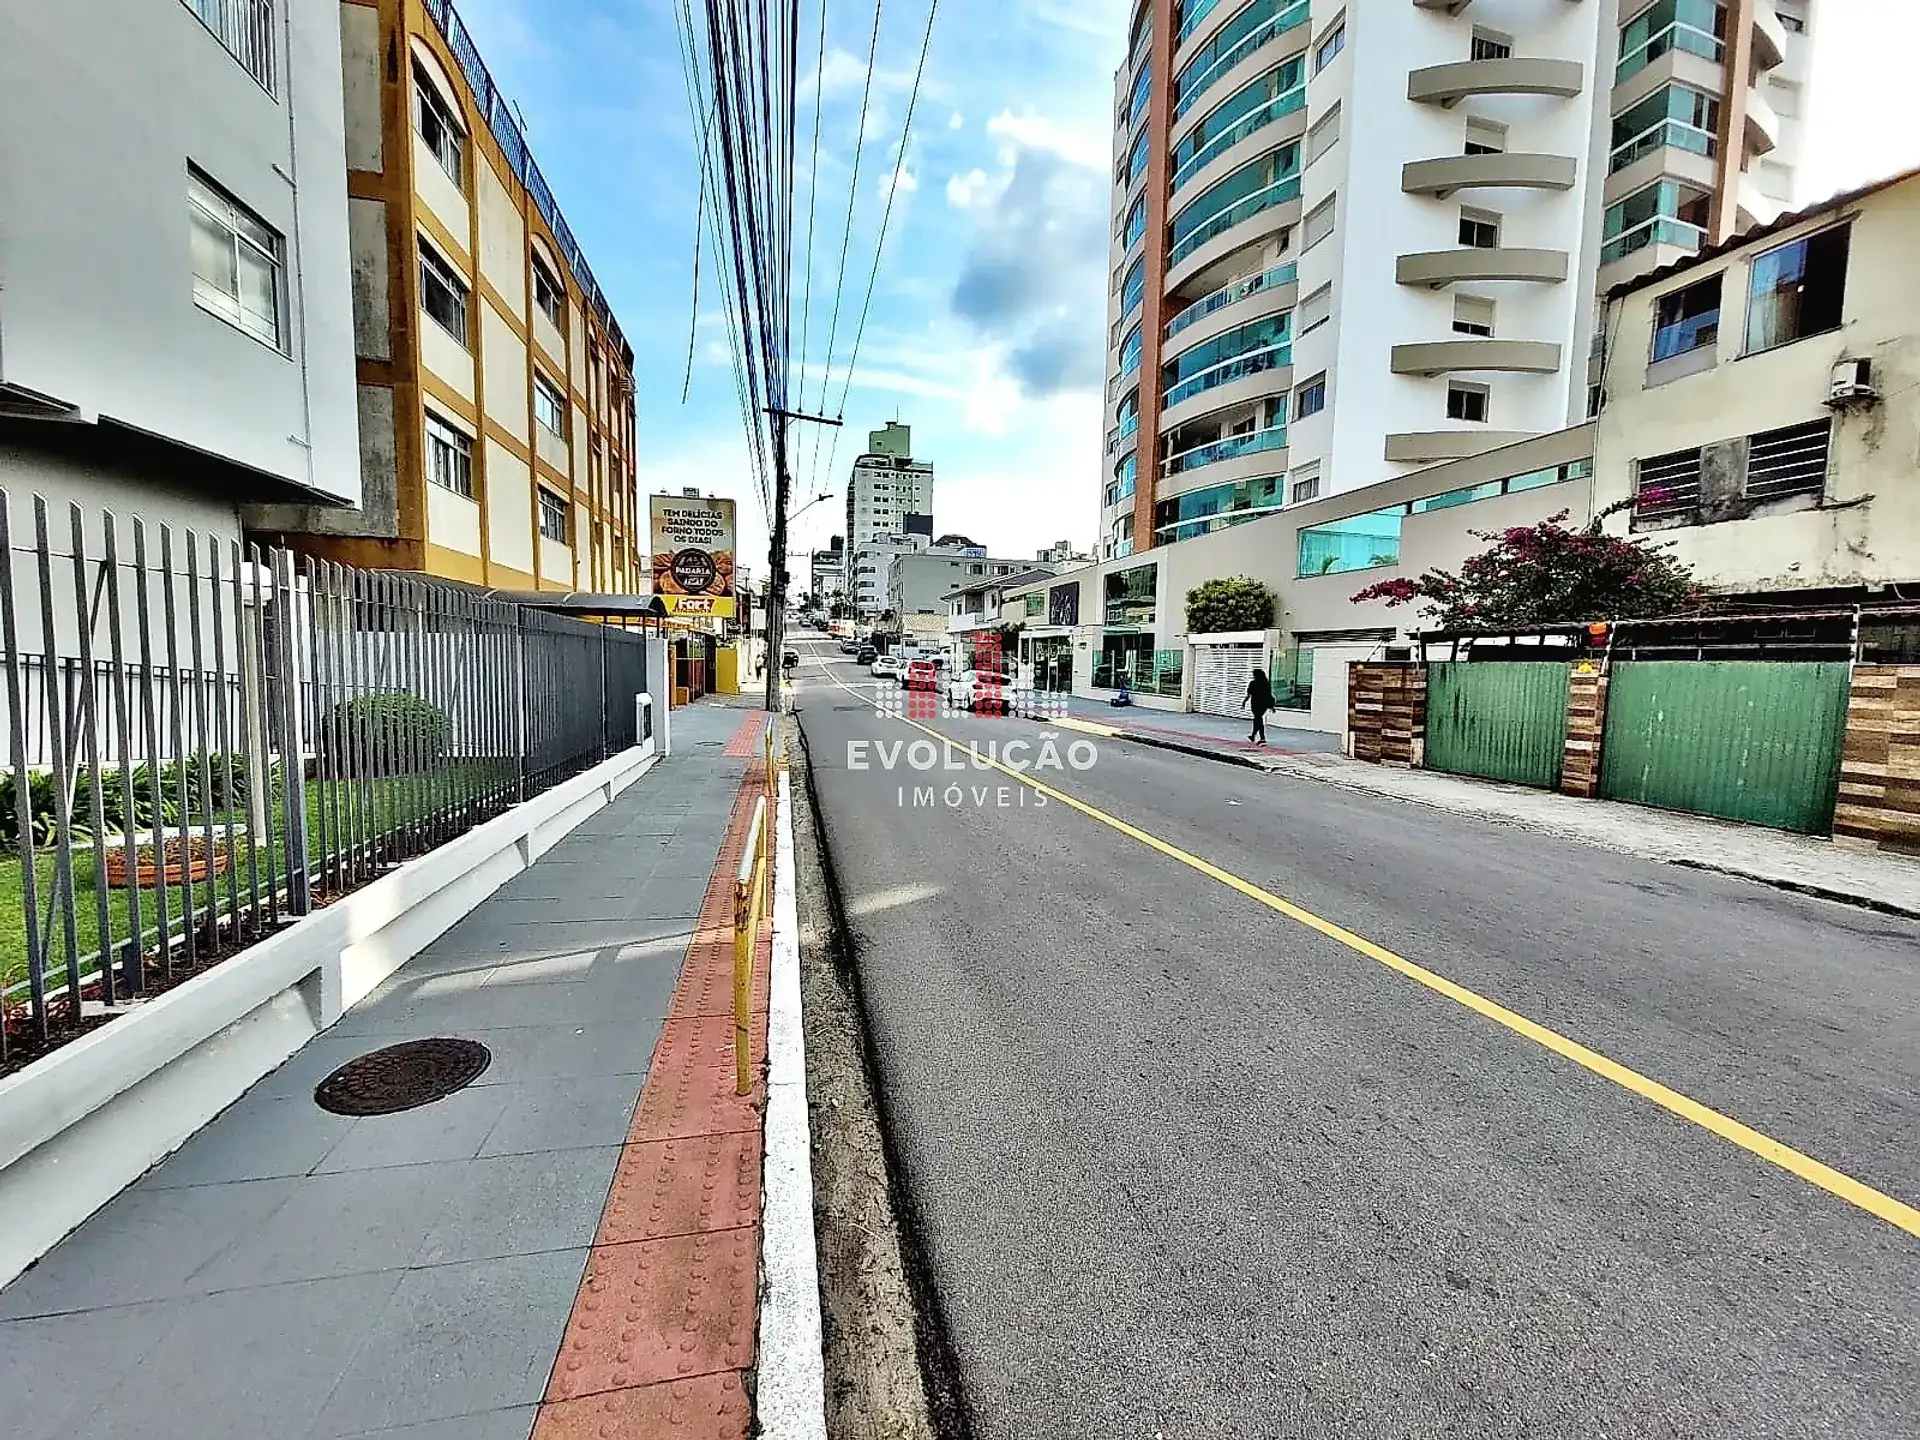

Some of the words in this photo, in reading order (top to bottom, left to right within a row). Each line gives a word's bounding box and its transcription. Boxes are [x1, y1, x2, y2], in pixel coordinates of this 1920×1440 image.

[663, 509, 681, 517] TEM
[682, 509, 723, 519] DELÍCIAS
[667, 518, 703, 527] SAINDO
[662, 526, 693, 535] FORNO
[694, 528, 723, 536] TODOS
[675, 567, 711, 575] PADARIA
[678, 599, 713, 610] Fort
